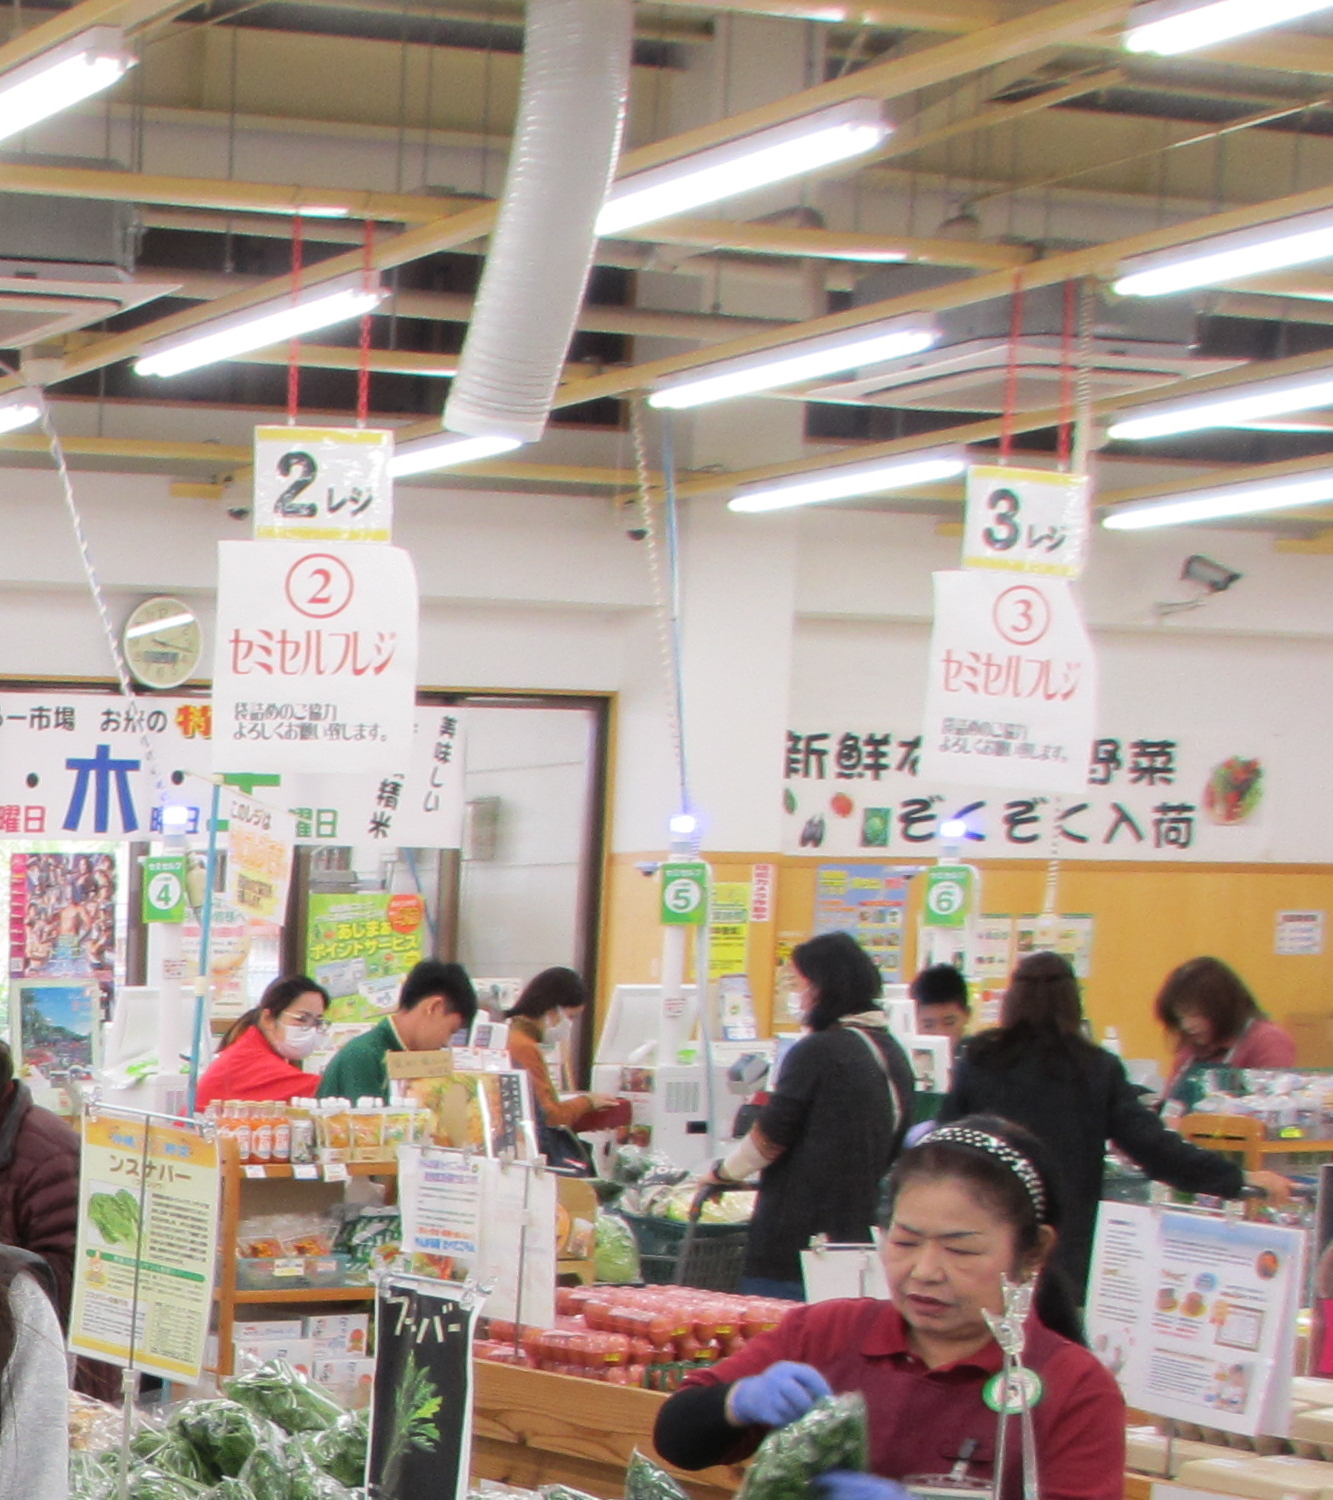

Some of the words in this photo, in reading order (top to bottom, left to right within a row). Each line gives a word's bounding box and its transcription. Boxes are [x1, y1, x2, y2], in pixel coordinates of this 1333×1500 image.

[229, 628, 397, 677] セミセルフレジ
[941, 649, 1082, 702] セミセルフレジ
[422, 716, 458, 813] 美味しい
[156, 882, 173, 907] 4
[673, 888, 692, 909] 5
[936, 887, 955, 913] 6
[310, 935, 419, 962] ポイントサービス
